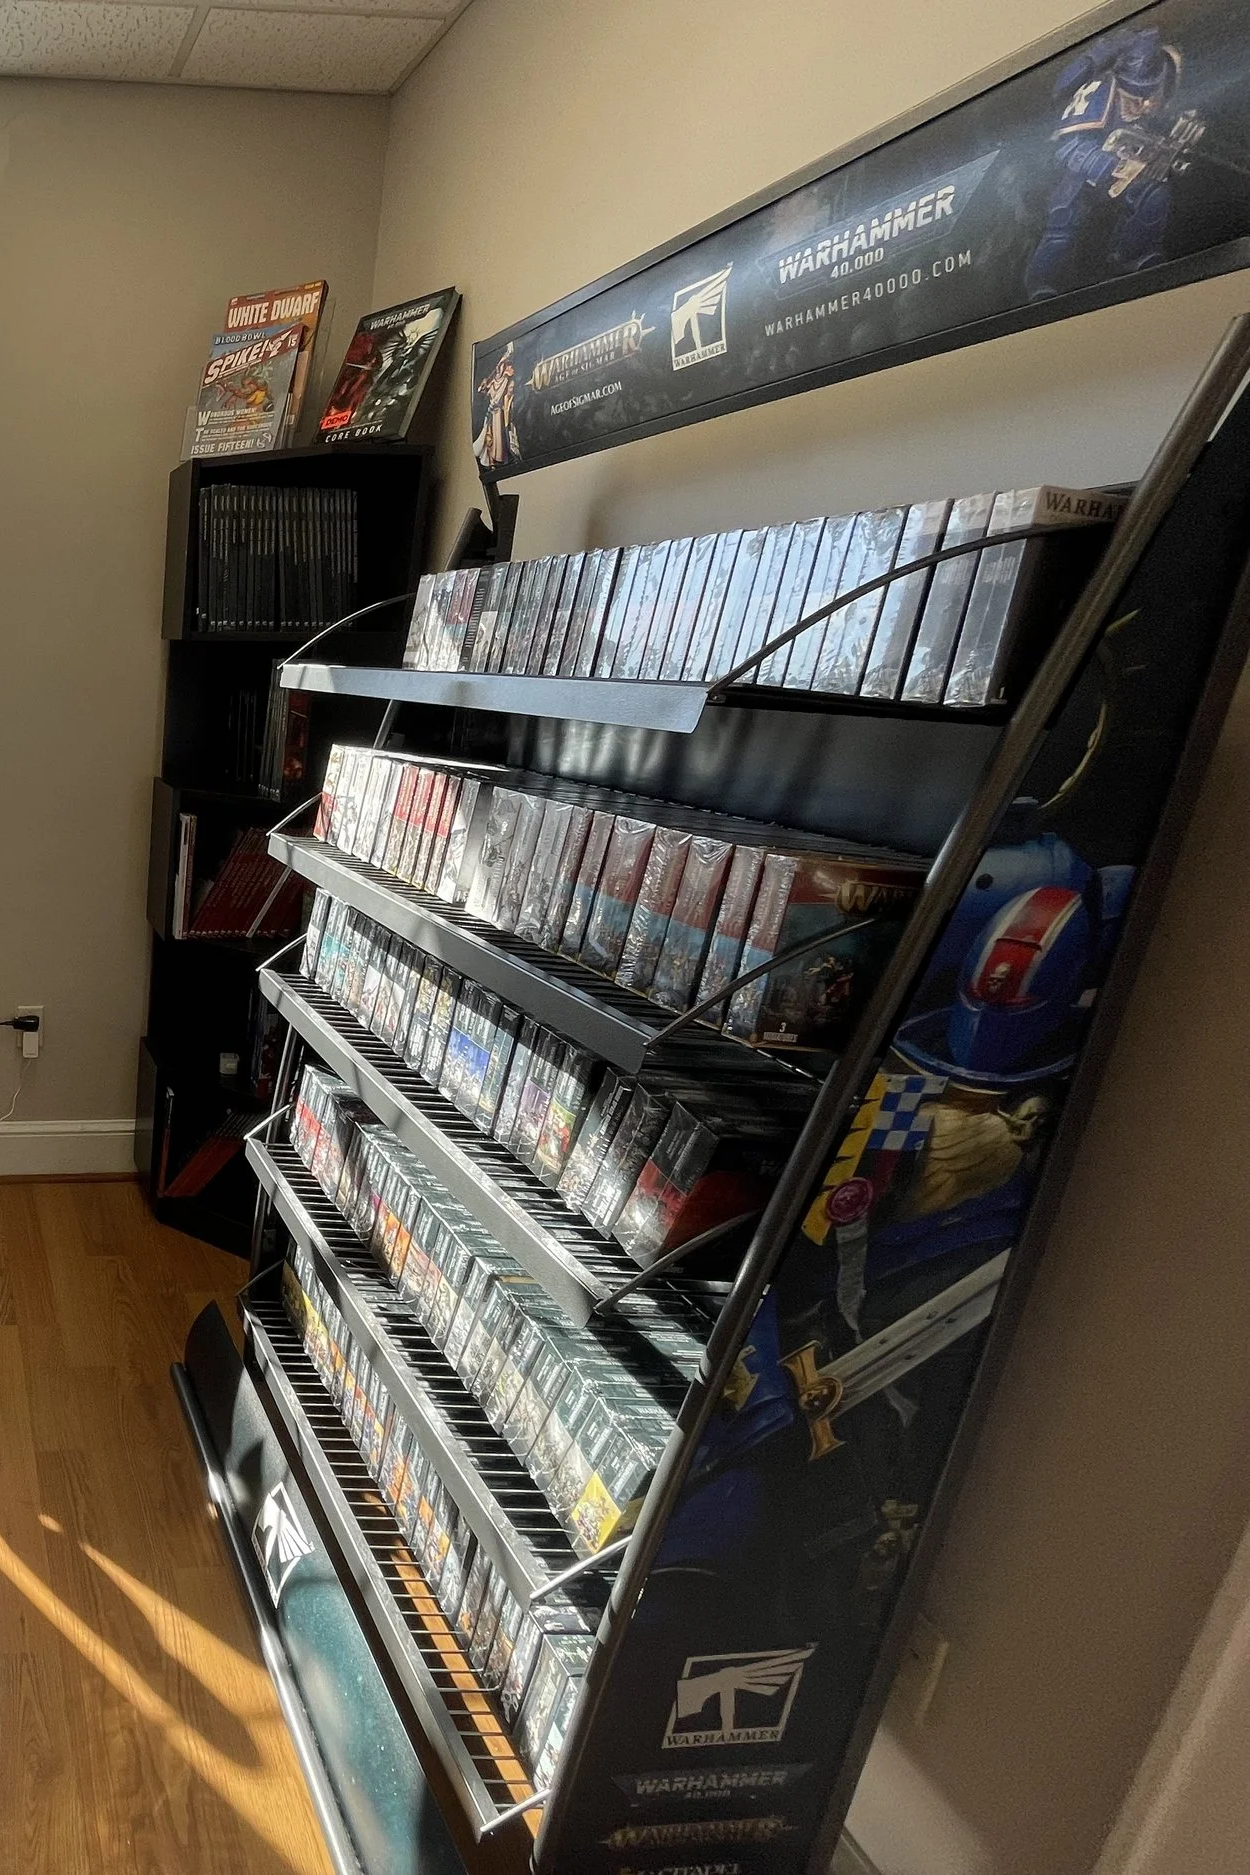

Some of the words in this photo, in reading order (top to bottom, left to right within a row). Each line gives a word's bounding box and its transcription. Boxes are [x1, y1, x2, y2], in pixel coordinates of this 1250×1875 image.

[778, 185, 956, 284] WARHAMMER
[764, 249, 971, 337] WARHAMMER40000.COM
[228, 302, 269, 328] WHITE
[271, 291, 320, 320] DWARF
[370, 303, 430, 330] WARHAMMER
[215, 334, 241, 345] BLOOD
[242, 332, 266, 341] BOWL
[205, 339, 269, 385] SPIKE!
[674, 343, 726, 368] WARHAMMER
[326, 415, 349, 426] DEMO
[325, 433, 350, 443] CORE
[355, 423, 382, 437] BOOK
[191, 444, 215, 454] ISSUE
[218, 439, 254, 452] FIFTEEN!
[779, 1022, 787, 1033] 3
[667, 1730, 781, 1746] WARHAMMER
[636, 1771, 787, 1795] WARHAMMER
